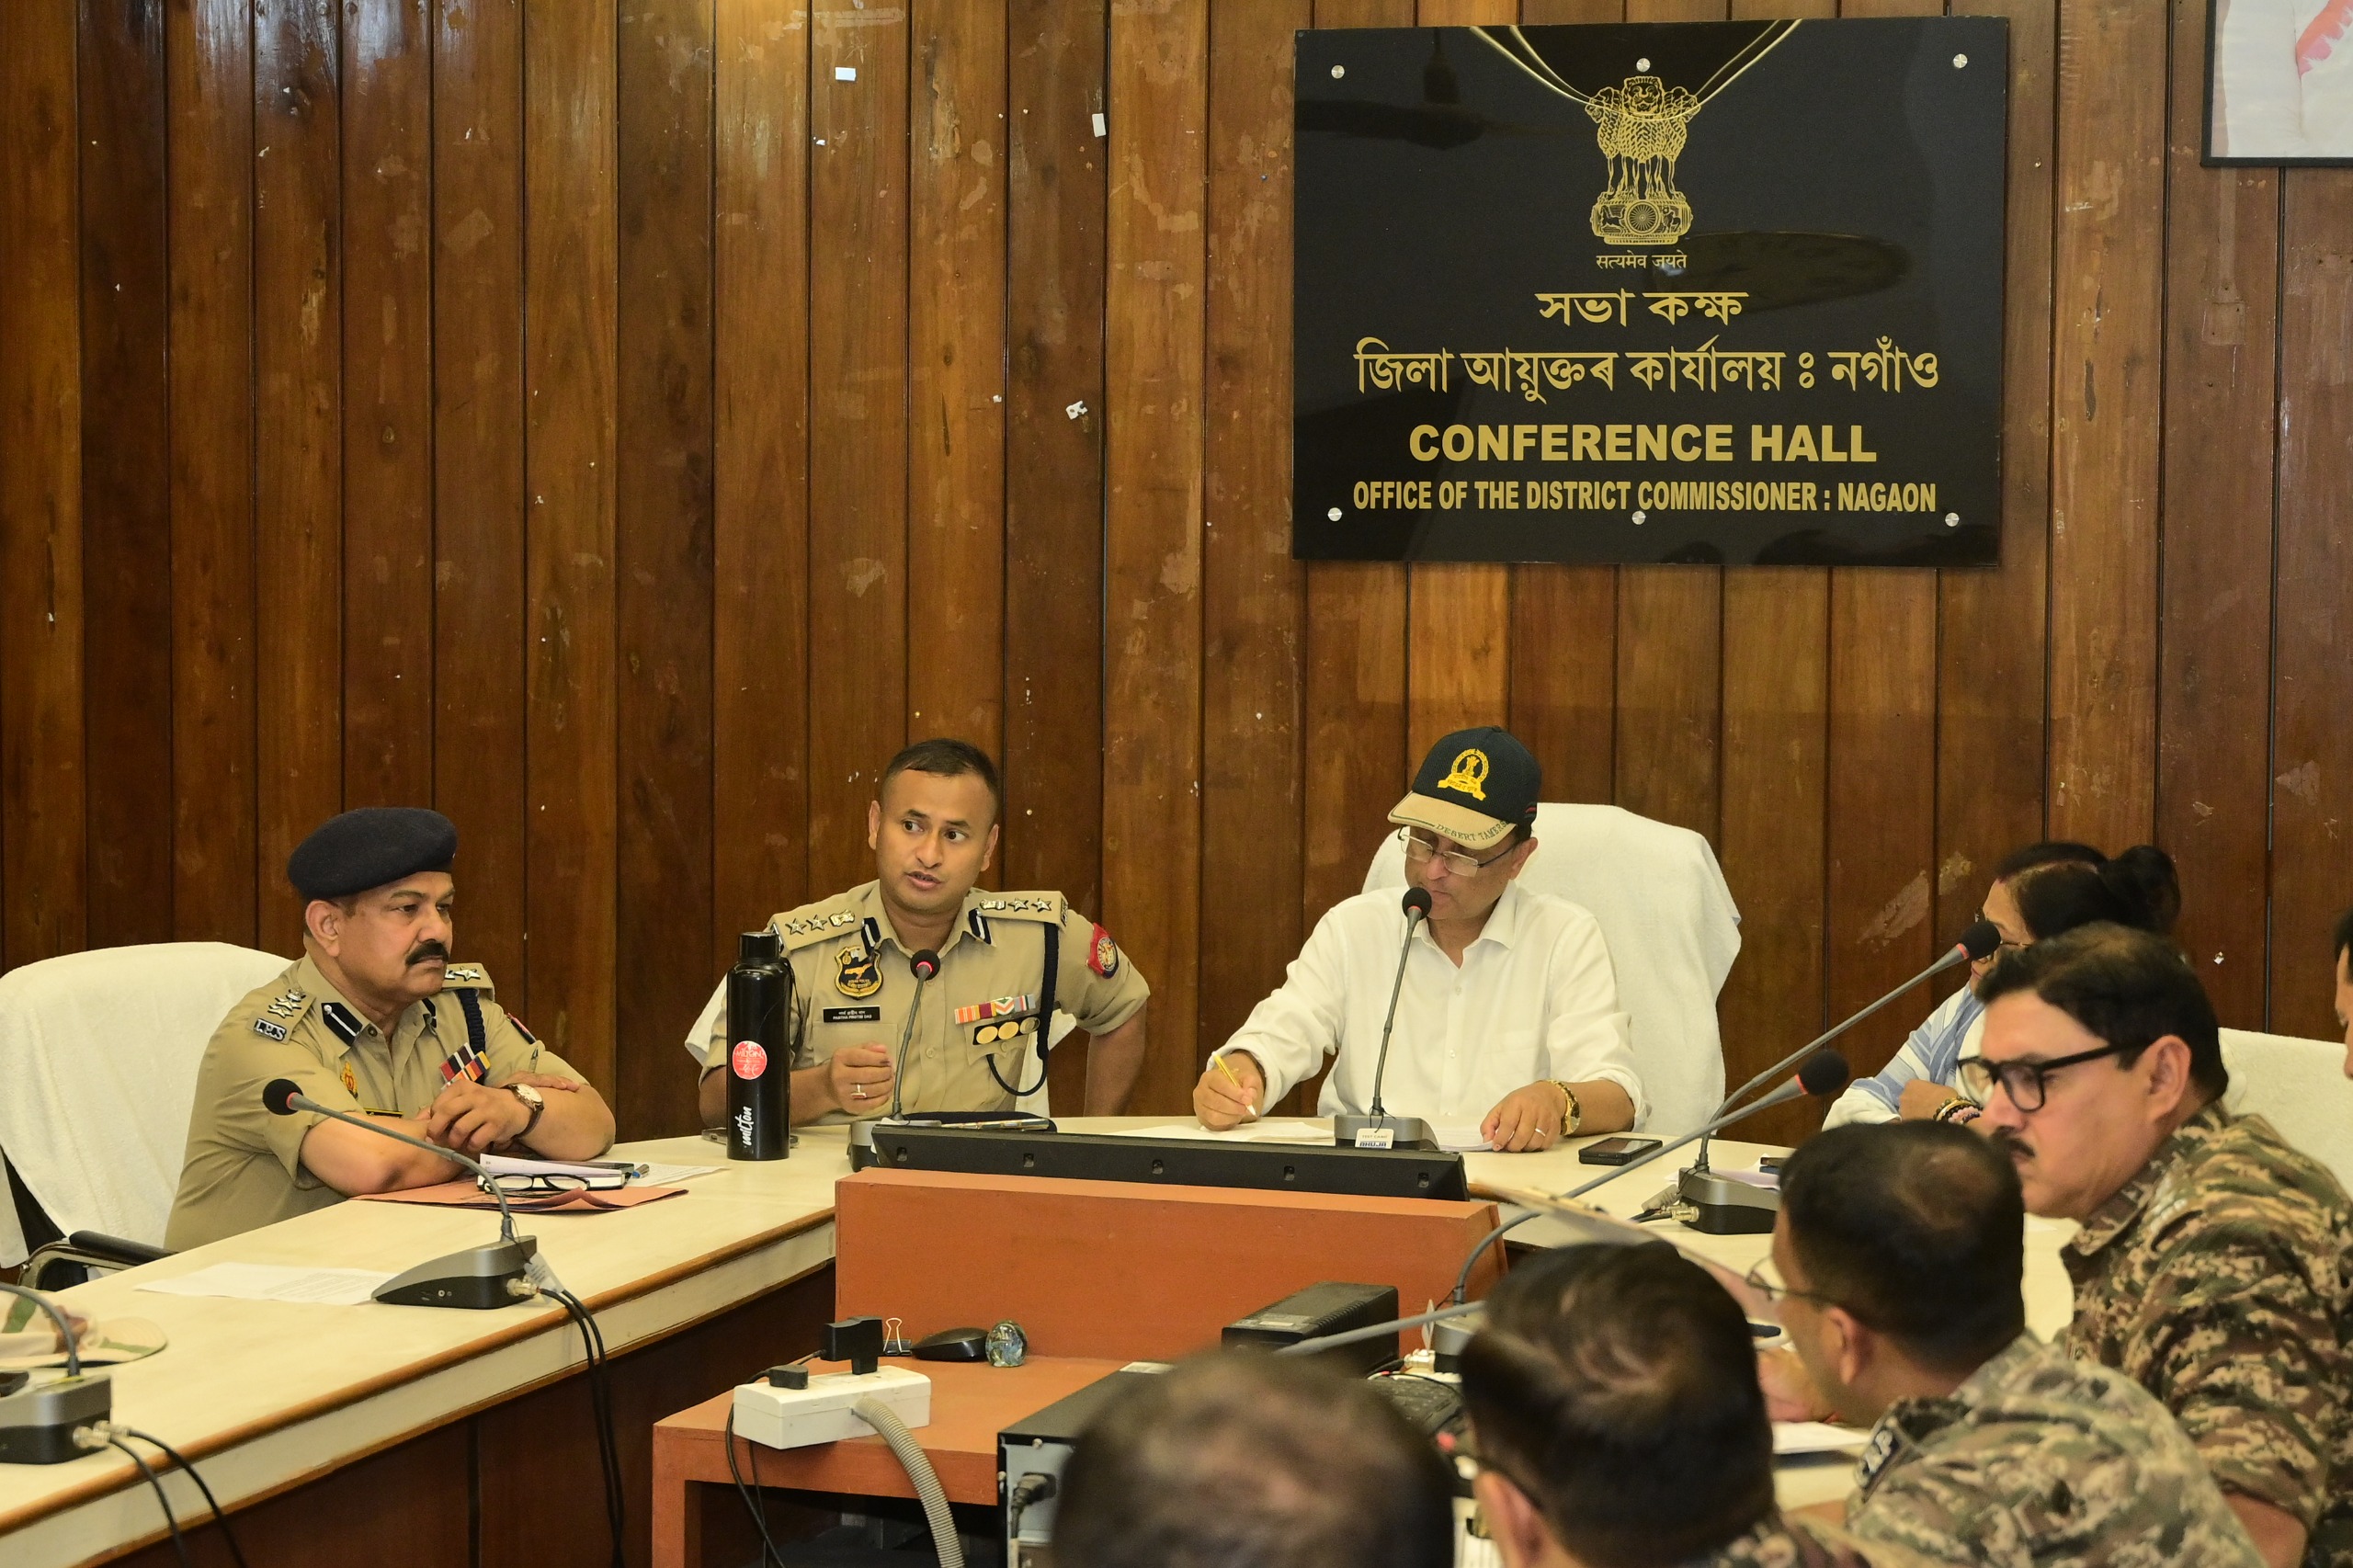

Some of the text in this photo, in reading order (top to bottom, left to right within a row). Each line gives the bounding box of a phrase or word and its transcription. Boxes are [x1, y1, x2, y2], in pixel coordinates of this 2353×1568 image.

[1596, 249, 1688, 269] सत्यमेव जयते
[1535, 289, 1749, 326] সভা কক্ষ
[1353, 336, 1454, 393] জিলা
[1461, 348, 1619, 404] আয়ুক্তৰ
[1828, 335, 1939, 392] নগাঁও
[1409, 424, 1878, 462] CONFERENCE HALL
[1353, 481, 1432, 510] OFFICE
[1438, 481, 1468, 510] OF
[1473, 481, 1519, 510] THE
[1526, 481, 1631, 511] DISTRICT
[1637, 481, 1817, 512] COMMISSIONER
[1837, 482, 1937, 513] NAGAON
[1436, 824, 1476, 842] DESERT
[734, 1106, 755, 1146] milton
